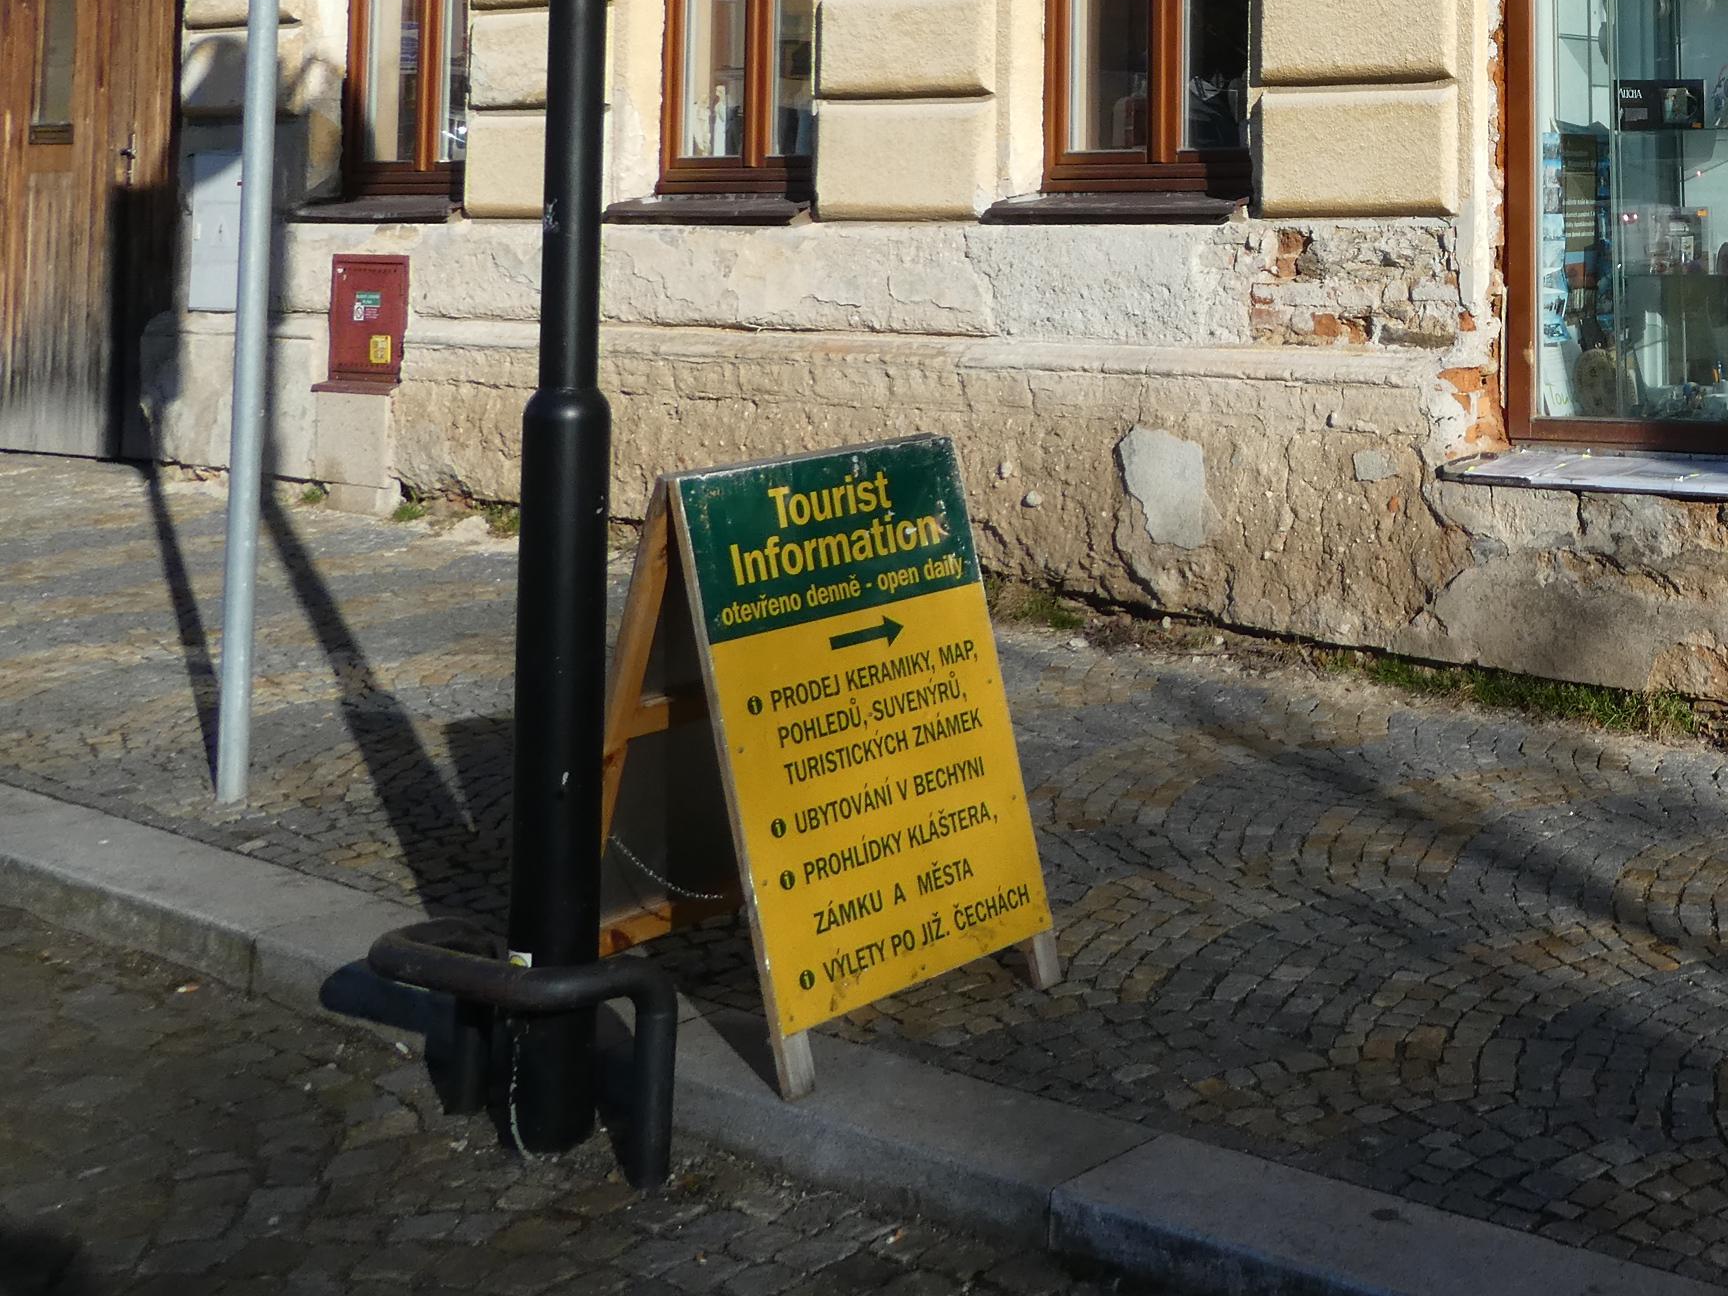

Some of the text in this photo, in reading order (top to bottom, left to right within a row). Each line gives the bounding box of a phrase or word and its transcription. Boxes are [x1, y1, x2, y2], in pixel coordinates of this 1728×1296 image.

[767, 471, 892, 528] Tourist
[729, 515, 941, 586] Information
[721, 593, 801, 626] otevřeno
[807, 574, 861, 608] denně
[877, 569, 919, 594] open
[924, 553, 963, 581] daily
[770, 639, 978, 712] PRODEJ KERAMIKY, MAP,
[778, 671, 967, 748] POHLEDŮ, SUVENÝRŮ,
[784, 708, 983, 785] TURISTICKÝCH ZNÁMEK
[795, 756, 985, 834] UBYTOVÁNÍ V BECHYNI
[803, 801, 998, 884] PROHLÍDKY KLÁŠTERA,
[813, 858, 974, 936] ZÁMKU A MĚSTA
[823, 884, 1031, 983] VÝLETY PO JIŽ. ČECHÁCH
